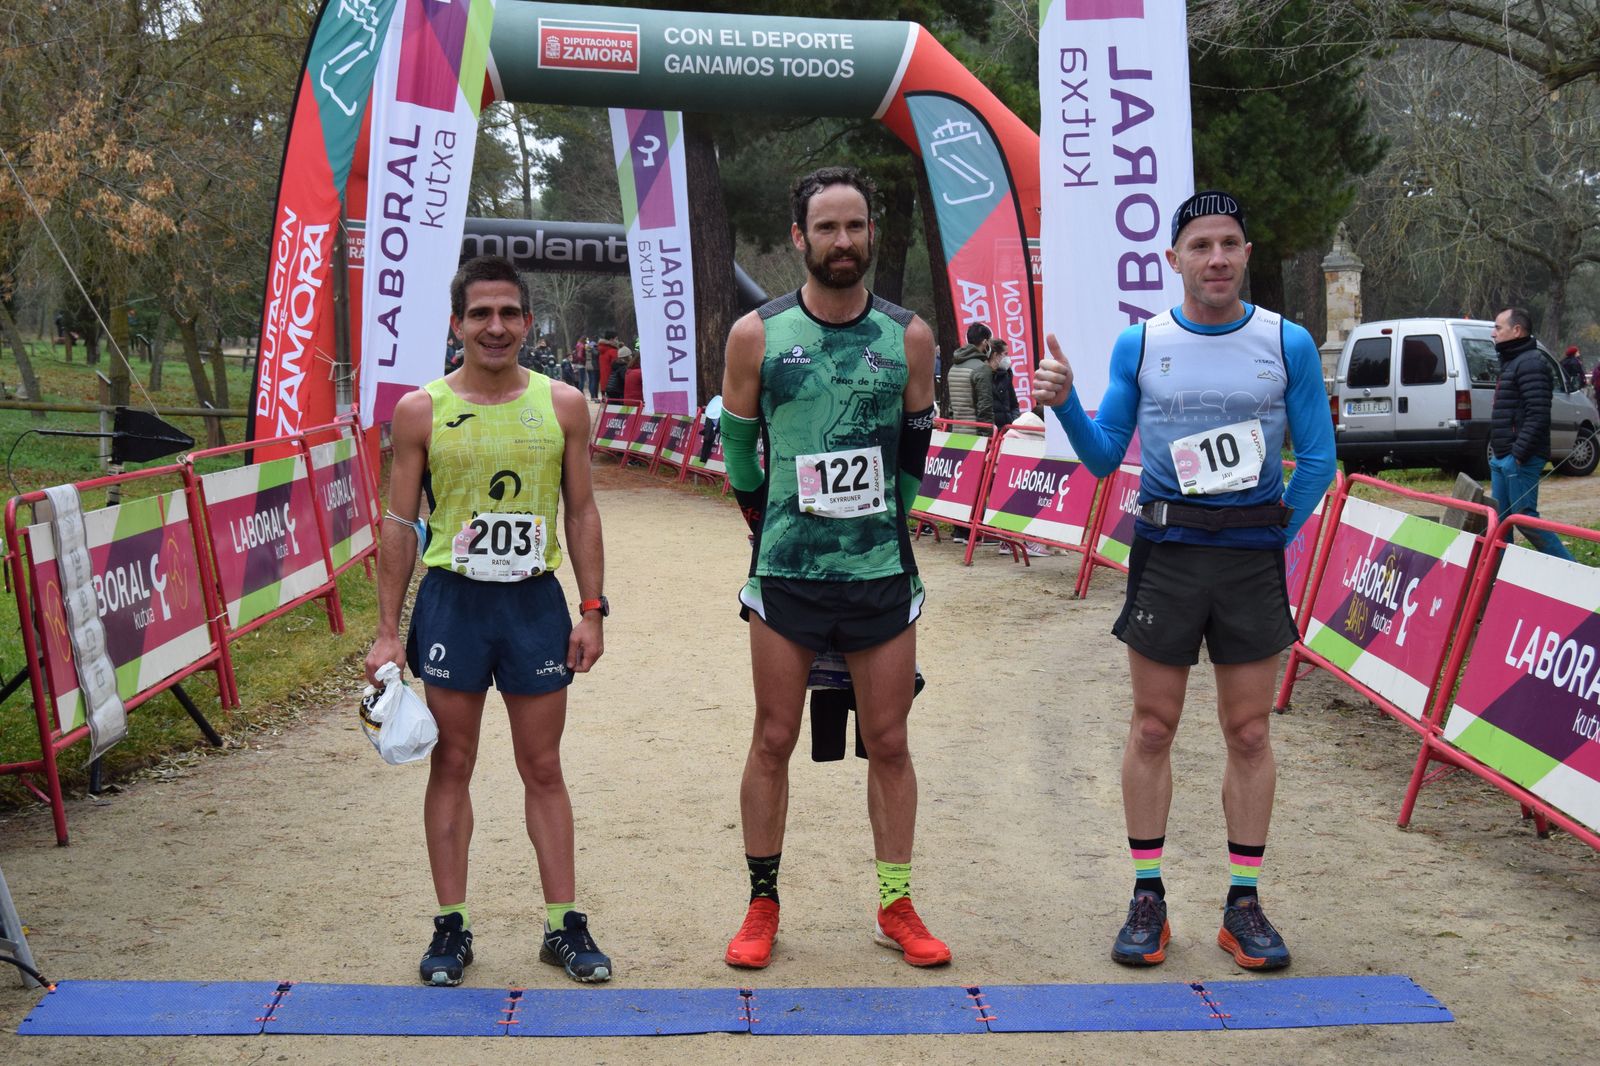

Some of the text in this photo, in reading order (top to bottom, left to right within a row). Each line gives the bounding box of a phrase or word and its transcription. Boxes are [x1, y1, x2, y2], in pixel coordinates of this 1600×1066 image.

[562, 46, 634, 63] ZAMORA
[563, 36, 633, 49] DIPUTACIÓN DE
[664, 27, 854, 51] CON EL DEPORTE
[664, 54, 855, 79] GANAMOS TODOS
[419, 129, 457, 229] kutxa
[1183, 194, 1238, 218] ALTITUD
[378, 124, 421, 367] LABORAL
[276, 224, 330, 446] ZAMORA
[783, 356, 812, 364] VIATOR
[1199, 432, 1241, 473] 10
[814, 455, 870, 495] 122
[1008, 467, 1056, 494] LABORAL
[1222, 471, 1233, 480] JAVI
[322, 477, 351, 512] LABORAL
[230, 506, 286, 554] LABORAL
[468, 519, 532, 556] 203
[91, 559, 151, 618] BORAL
[133, 607, 155, 632] kutxa
[1370, 609, 1393, 635] kutxa
[1504, 618, 1600, 706] LABORA
[1571, 708, 1600, 744] kutx
